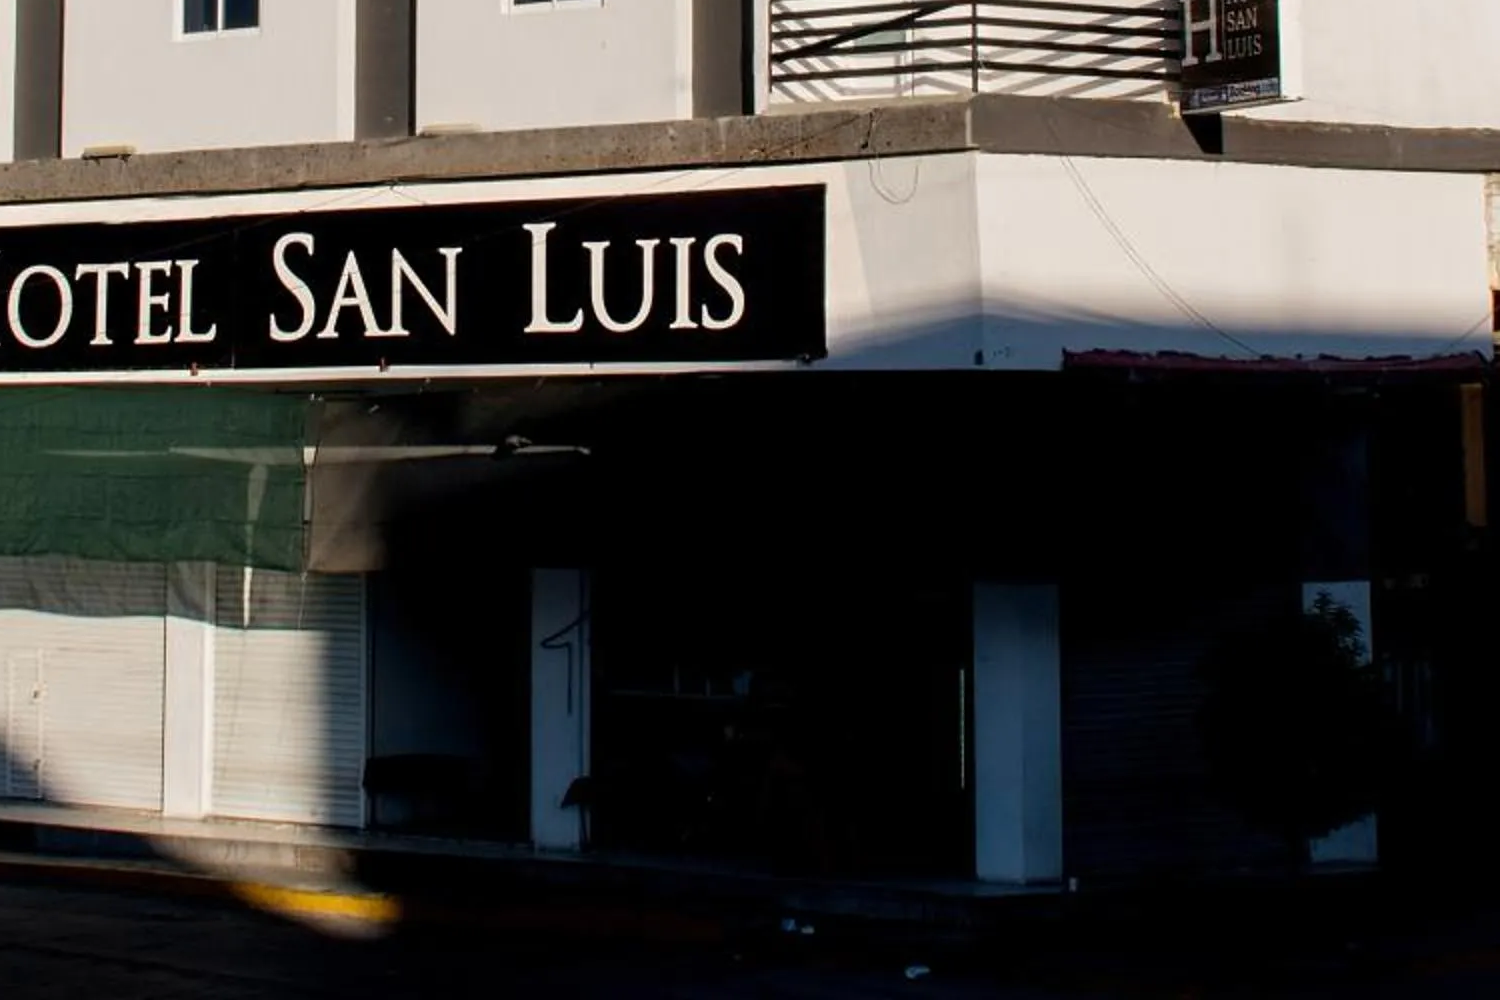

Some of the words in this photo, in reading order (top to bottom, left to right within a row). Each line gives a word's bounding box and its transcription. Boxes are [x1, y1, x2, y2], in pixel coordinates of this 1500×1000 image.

[1227, 6, 1258, 32] SAN
[1227, 34, 1262, 59] LUIS
[269, 231, 463, 342] SAN
[523, 221, 746, 334] LUIS
